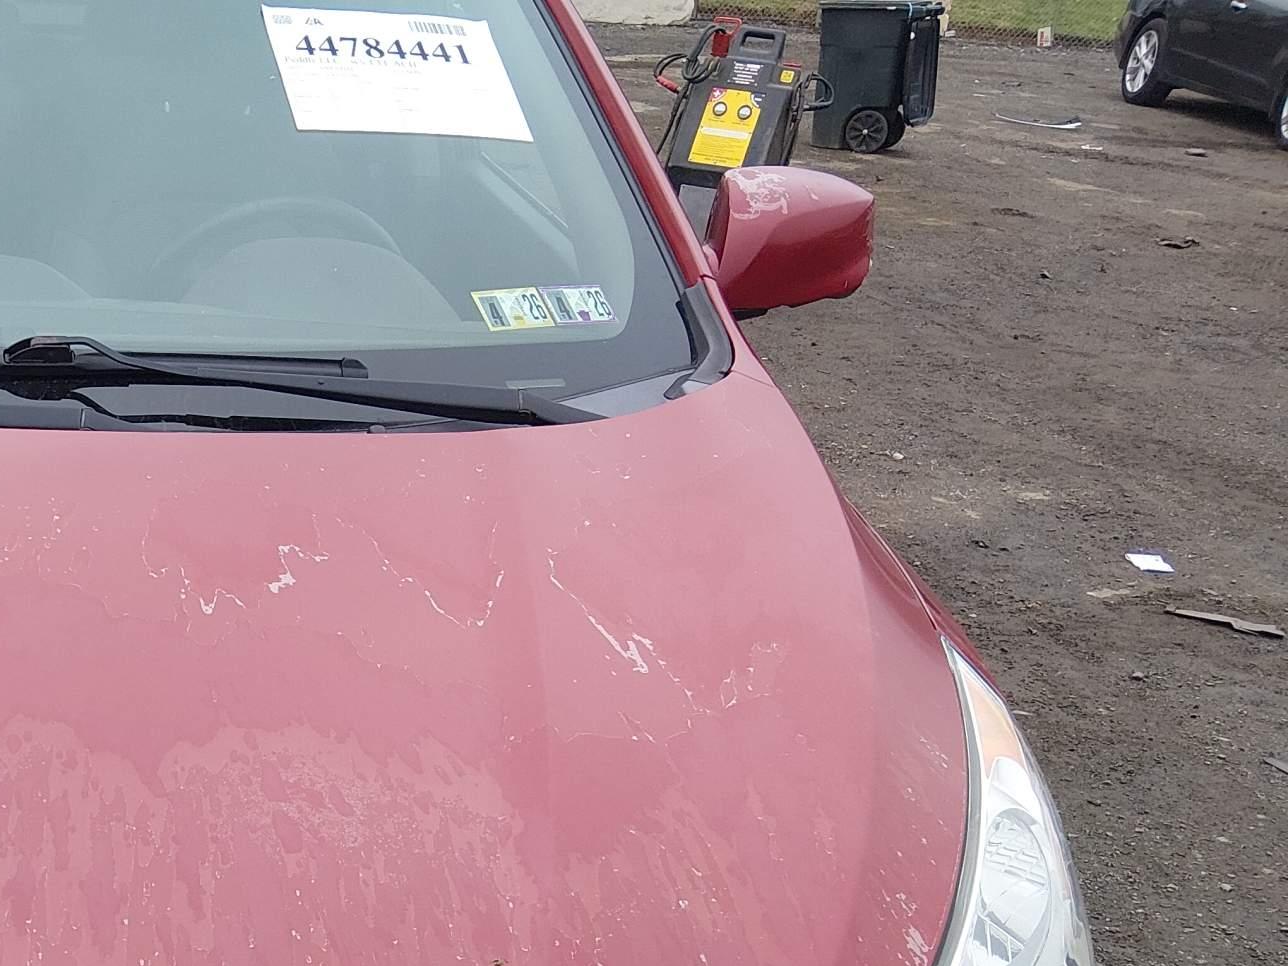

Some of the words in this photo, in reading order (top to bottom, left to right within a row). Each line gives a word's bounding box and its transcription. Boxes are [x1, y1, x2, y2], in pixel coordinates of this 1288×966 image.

[295, 34, 472, 65] 44784441
[521, 293, 548, 320] 26
[587, 290, 612, 317] 26
